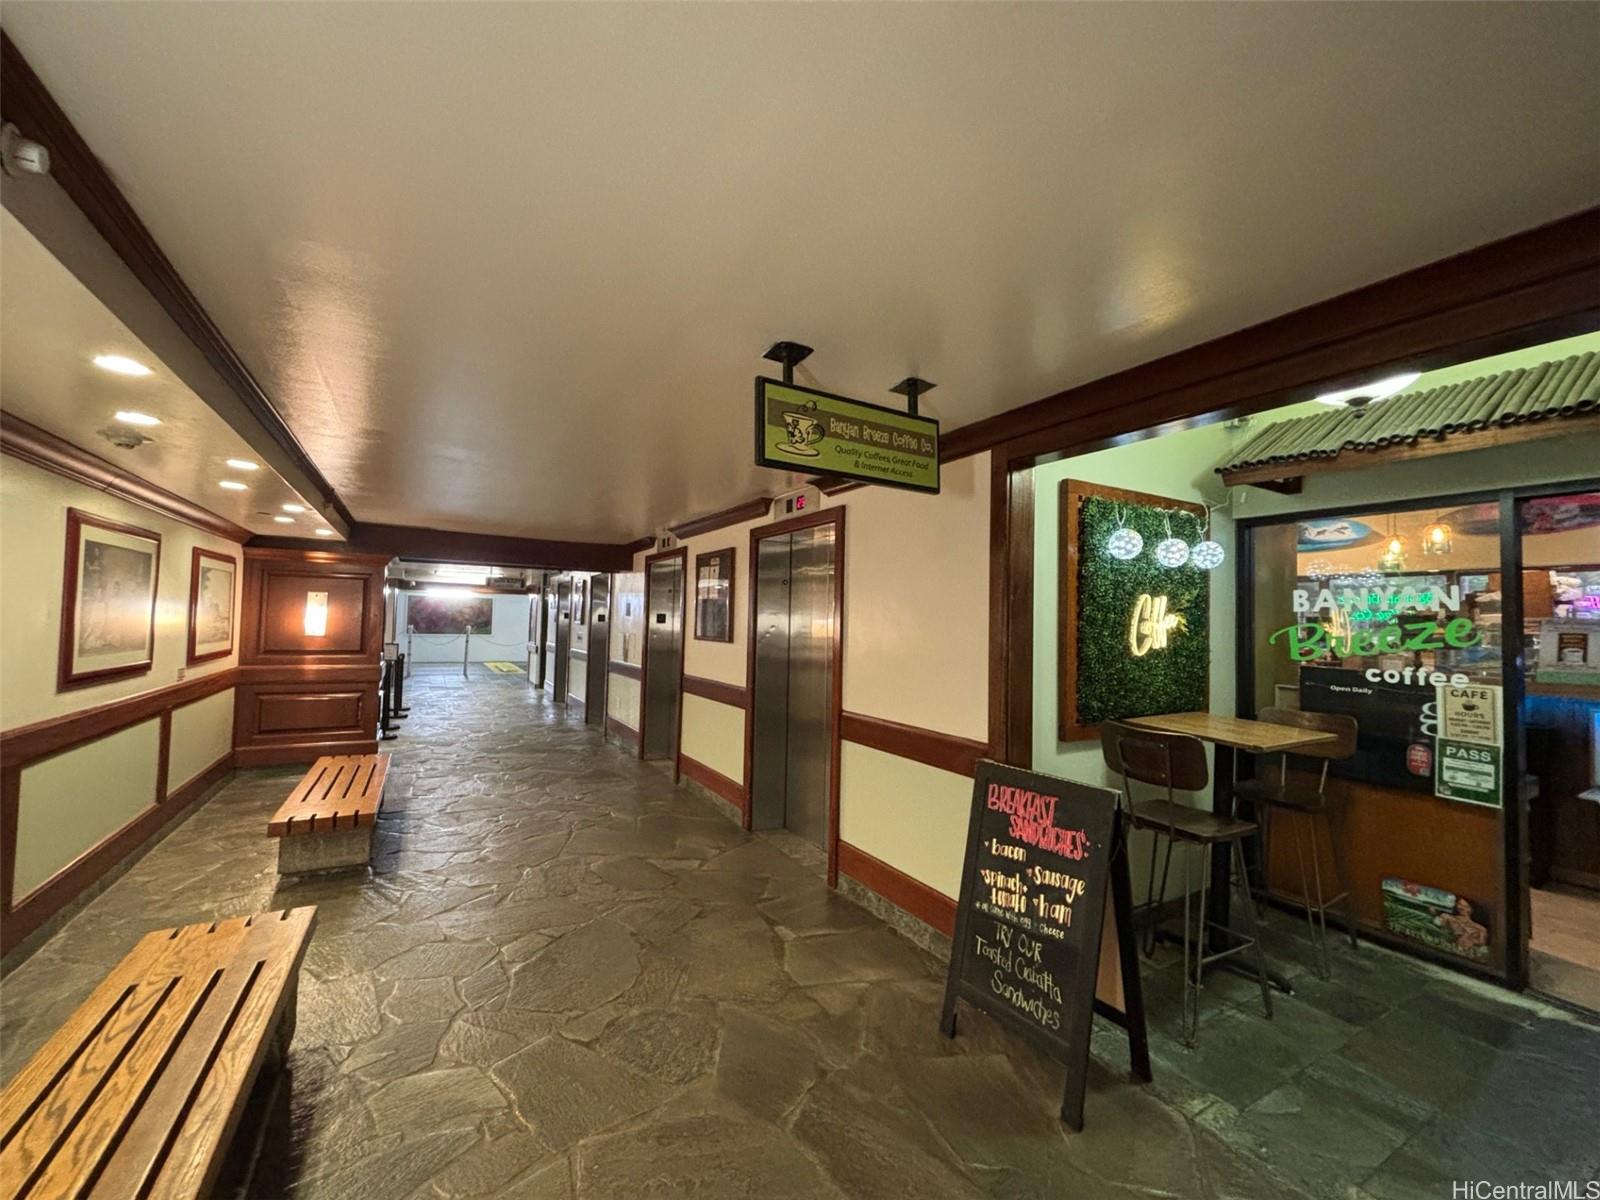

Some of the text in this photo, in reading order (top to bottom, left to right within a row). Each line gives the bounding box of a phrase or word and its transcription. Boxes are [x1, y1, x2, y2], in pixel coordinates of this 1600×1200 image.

[830, 417, 859, 440] Banyan
[893, 431, 918, 450] Coffee
[834, 444, 862, 458] Quality
[891, 456, 912, 467] Great
[912, 460, 929, 470] Food
[861, 462, 889, 474] Internet
[891, 468, 914, 477] Access
[1292, 585, 1460, 612] BANYAN
[1268, 617, 1484, 662] Breeze
[1330, 685, 1373, 695] Open Daily
[1365, 666, 1470, 688] coffee
[1445, 746, 1492, 762] PASS
[988, 783, 1058, 826] BREAKFAST
[992, 838, 1026, 861] bacon
[1039, 893, 1072, 927] ham
[994, 921, 1042, 963] TRY OUR
[991, 970, 1060, 1030] Sandwiches
